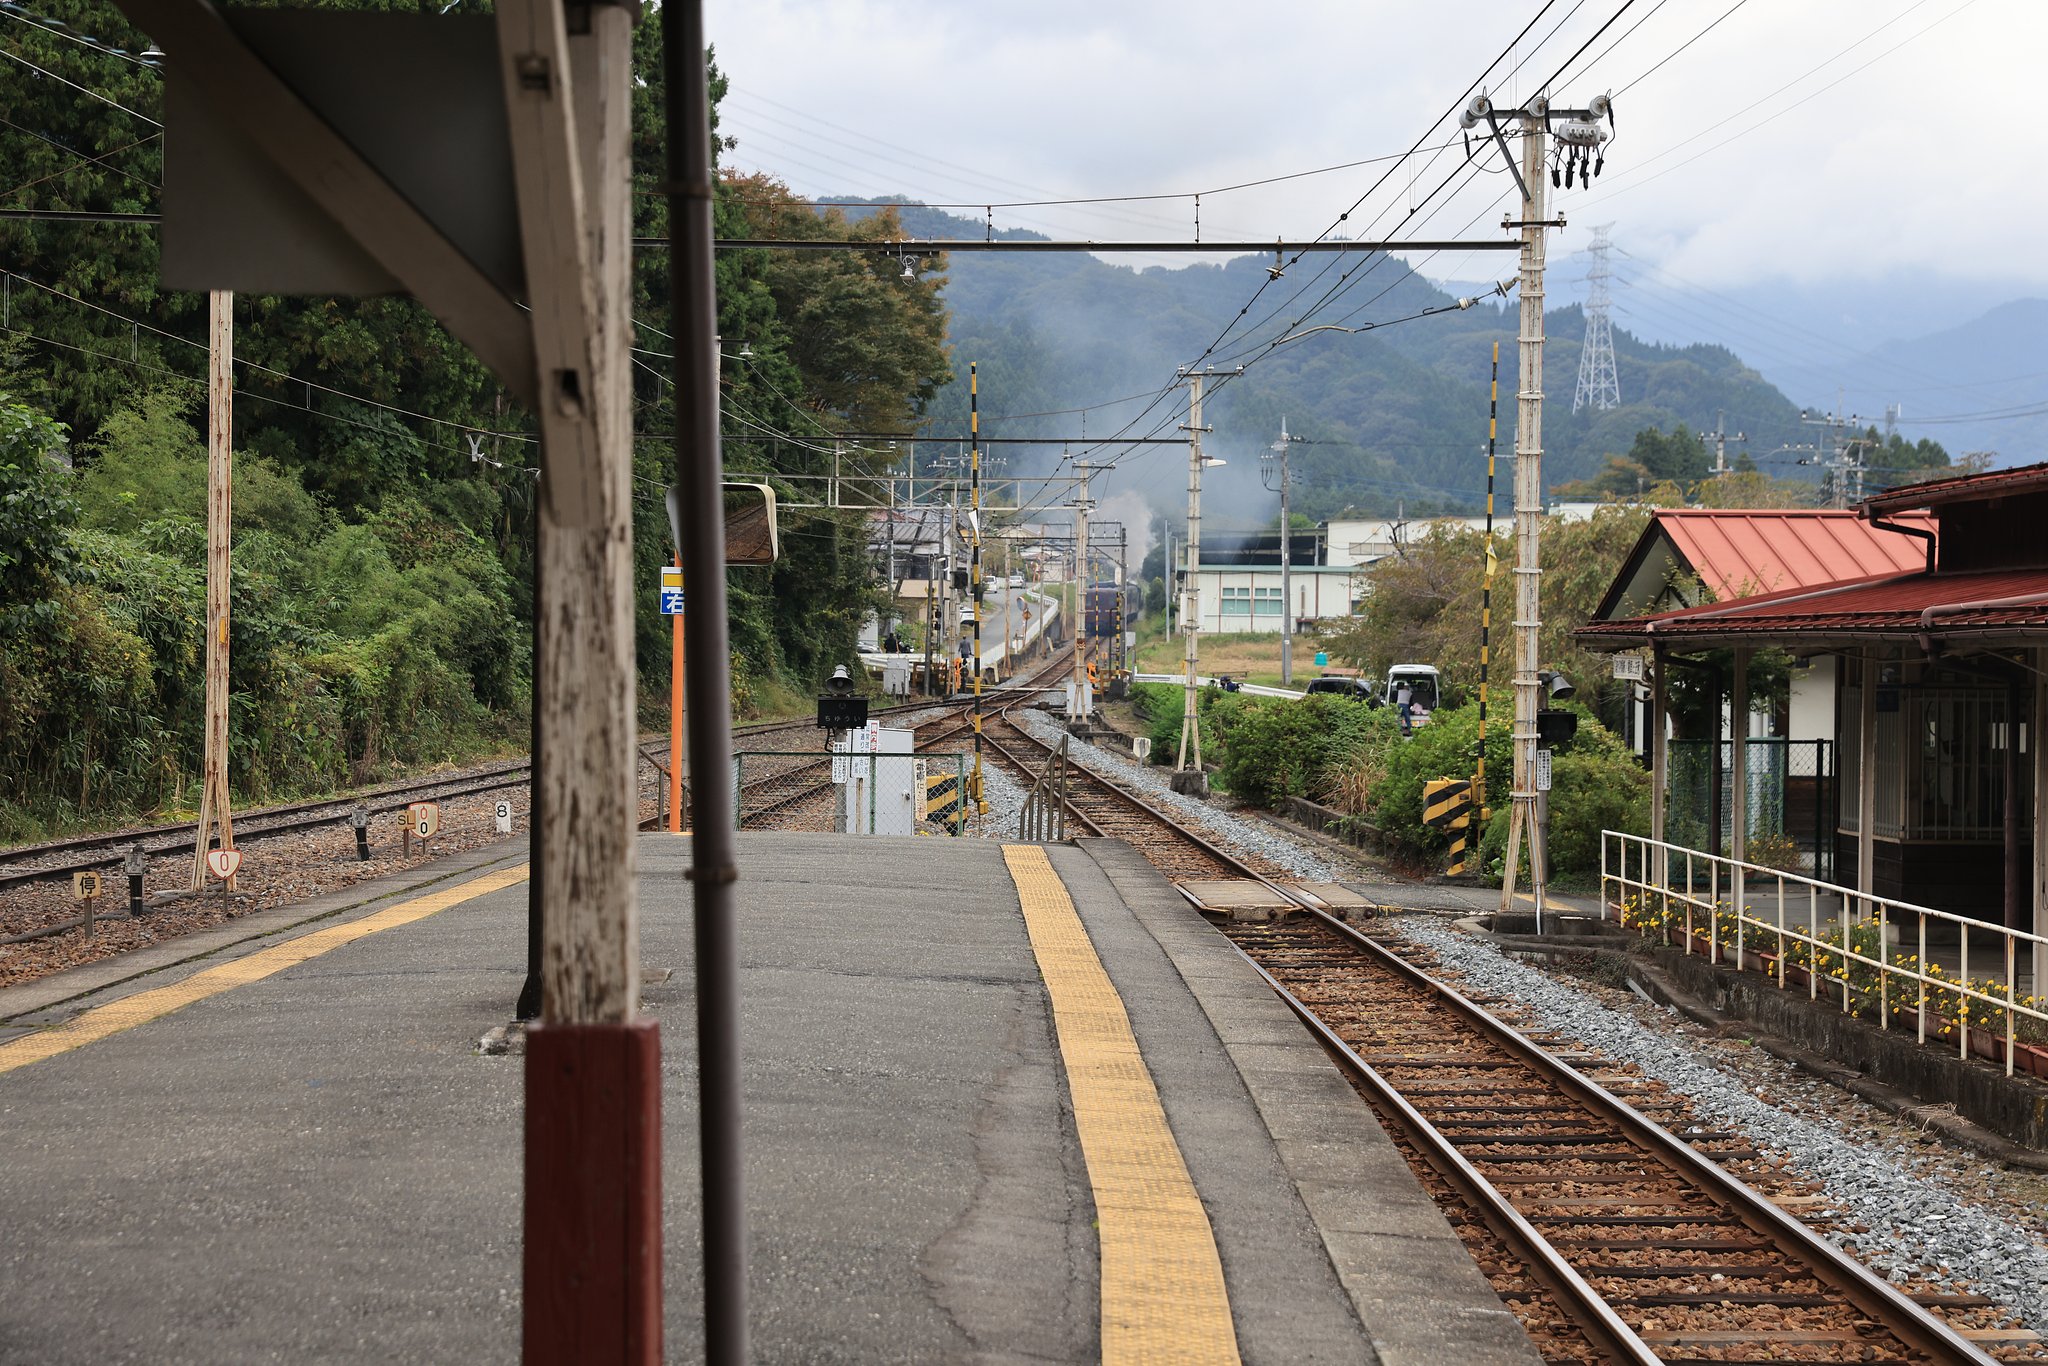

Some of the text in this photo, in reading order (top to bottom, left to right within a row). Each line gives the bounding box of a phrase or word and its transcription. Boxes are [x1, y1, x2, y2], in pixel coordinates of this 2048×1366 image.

[825, 714, 861, 722] ちゅうい
[420, 806, 428, 820] 0
[497, 805, 507, 817] 8
[398, 815, 415, 825] SL
[420, 821, 428, 835] 0
[220, 854, 229, 871] 0
[79, 875, 97, 895] 停
